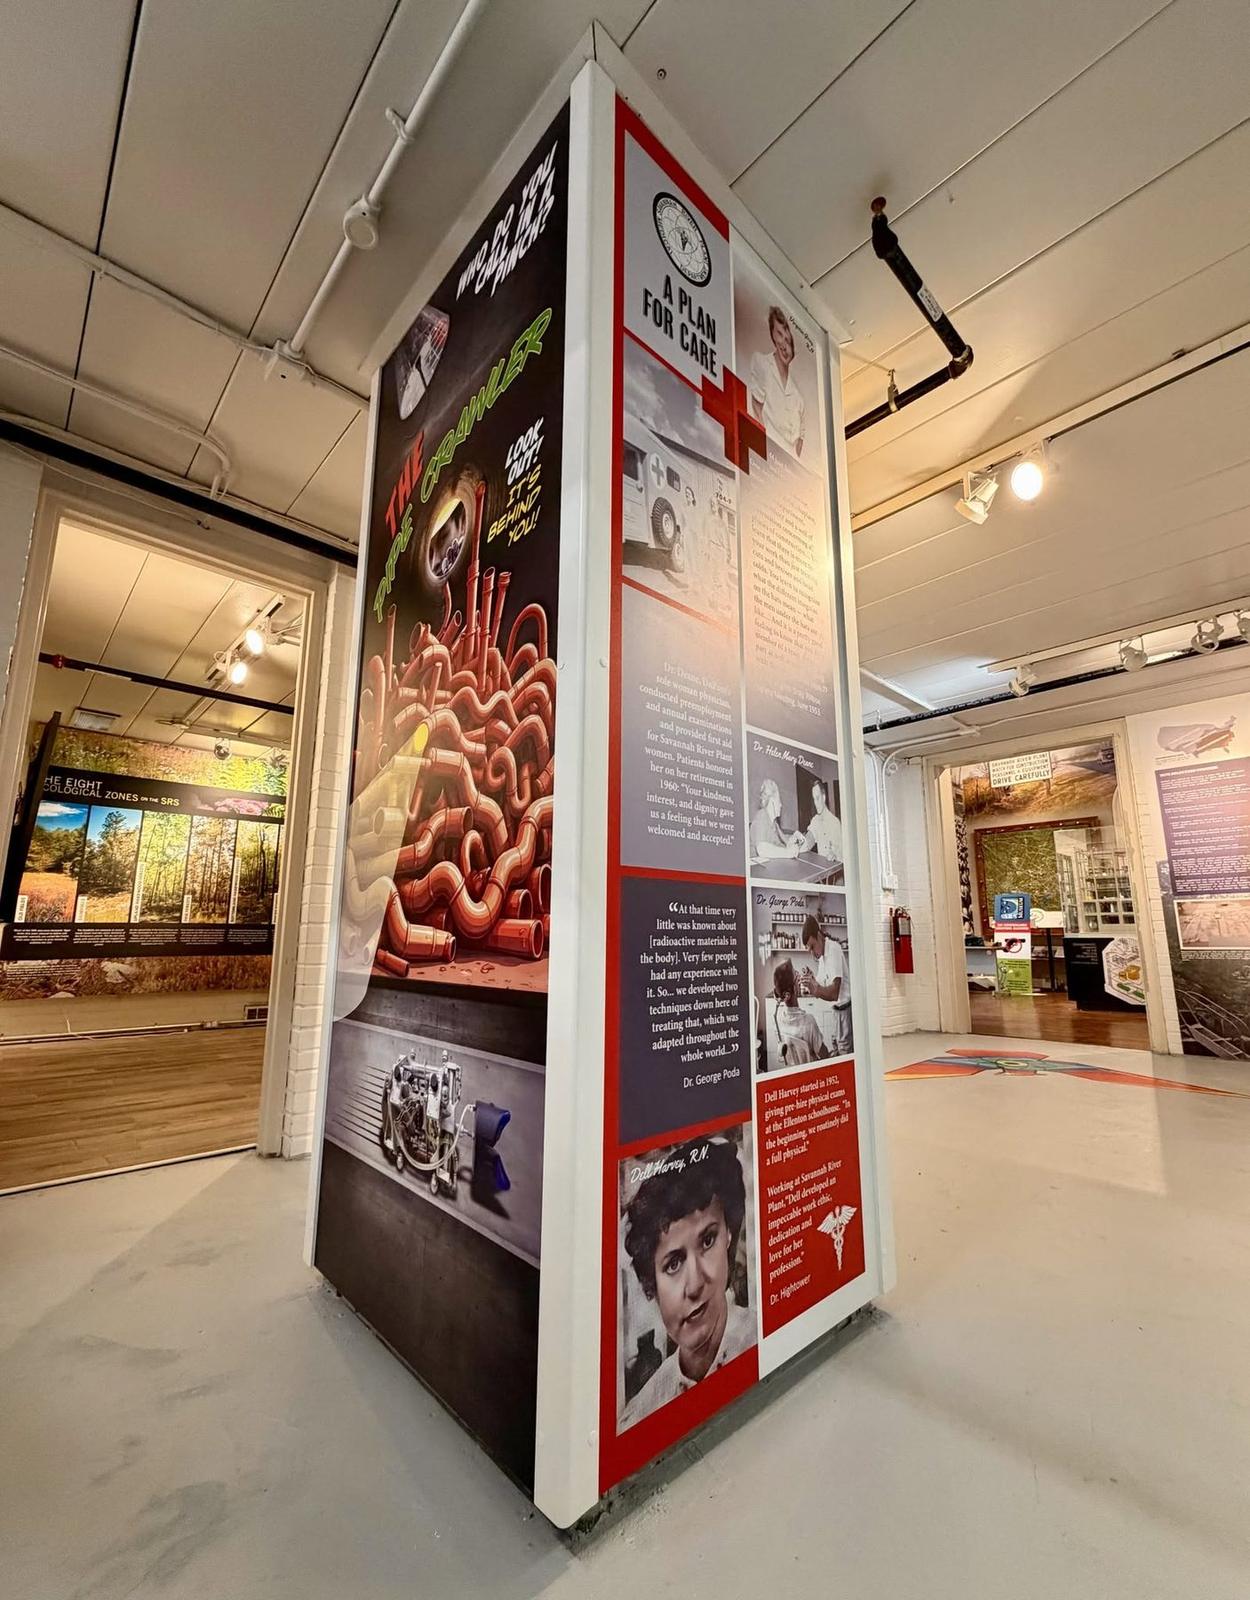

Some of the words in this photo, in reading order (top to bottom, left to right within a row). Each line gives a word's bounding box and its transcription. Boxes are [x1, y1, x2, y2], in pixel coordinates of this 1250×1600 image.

[456, 240, 488, 300] WHO
[491, 204, 514, 253] DO
[518, 140, 558, 215] YOU
[475, 231, 509, 294] CALL
[515, 193, 537, 242] IN
[538, 167, 555, 212] A
[490, 195, 554, 297] PINCH?
[662, 274, 673, 305] A
[678, 286, 716, 346] PLAN
[642, 287, 674, 340] FOR
[680, 322, 717, 378] CARE
[505, 416, 544, 469] LOOK
[373, 504, 413, 623] PIPE
[420, 308, 552, 503] CRAWLER
[507, 435, 544, 485] OUT!
[385, 430, 425, 538] THE
[506, 464, 542, 508] IT'S
[487, 485, 542, 544] BEHIND
[508, 505, 541, 547] YOU!
[640, 685, 678, 703] conducted
[656, 676, 670, 687] sole
[672, 681, 697, 696] woman
[646, 702, 660, 712] and
[662, 707, 686, 720] annual
[688, 716, 731, 735] examinations
[647, 730, 659, 743] for
[660, 734, 694, 751] Savannah
[696, 744, 714, 756] River
[716, 750, 732, 762] Plant
[659, 721, 673, 731] and
[675, 726, 706, 743] provided
[708, 734, 721, 745] first
[722, 738, 732, 748] aid
[645, 747, 675, 760] women.
[677, 753, 704, 768] Patients
[705, 760, 732, 775] honored
[753, 741, 765, 754] Dr.
[765, 745, 782, 760] Helen
[782, 750, 798, 767] Mary
[797, 755, 814, 769] Deane
[44, 775, 61, 786] HE
[65, 777, 102, 790] EIGHT
[650, 760, 663, 772] her
[676, 767, 688, 779] her
[690, 773, 724, 787] retirement
[993, 775, 1011, 785] DRIVE
[1015, 770, 1049, 781] CAREFULLY
[43, 783, 102, 798] COLOGICAL
[104, 791, 138, 802] ZONES
[160, 797, 180, 806] SRS
[647, 792, 677, 807] interest,
[679, 800, 692, 809] and
[694, 801, 718, 816] dignity
[719, 808, 734, 817] gave
[660, 779, 679, 791] 1960:
[703, 788, 733, 804] kindness,
[648, 824, 685, 838] welcomed
[687, 830, 700, 840] and
[667, 810, 692, 826] feeling
[693, 816, 706, 826] that
[719, 822, 734, 831] were
[657, 919, 674, 929] little
[692, 920, 716, 929] known
[717, 921, 736, 930] about
[689, 905, 703, 914] that
[705, 906, 720, 914] time
[722, 908, 736, 918] very
[650, 935, 695, 948] [radioactive
[697, 936, 728, 945] materials
[640, 953, 653, 963] the
[655, 952, 680, 965] body].
[682, 952, 699, 964] Very
[701, 951, 713, 961] few
[715, 951, 737, 963] people
[651, 969, 665, 980] had
[667, 971, 681, 981] any
[683, 968, 721, 980] experience
[723, 966, 737, 975] with
[657, 986, 674, 997] So...
[688, 982, 724, 995] developed
[725, 983, 738, 991] two
[650, 1003, 691, 1015] techniques
[693, 1000, 713, 1010] down
[715, 998, 730, 1008] here
[731, 995, 739, 1006] of
[652, 1020, 683, 1032] treating
[685, 1017, 702, 1028] that,
[704, 1014, 724, 1025] which
[652, 1035, 684, 1051] adapted
[686, 1030, 726, 1044] throughout
[728, 1027, 739, 1037] the
[681, 1049, 703, 1061] whole
[684, 1077, 693, 1087] Dr.
[696, 1073, 721, 1084] George
[723, 1067, 739, 1078] Poda
[765, 1091, 777, 1102] Dell
[779, 1088, 799, 1099] Harvey
[800, 1080, 818, 1093] started
[765, 1107, 784, 1121] giving
[785, 1099, 807, 1115] pre-hire
[808, 1091, 829, 1108] physical
[766, 1139, 776, 1149] the
[817, 1116, 839, 1131] routinely
[840, 1113, 848, 1123] did
[772, 1121, 782, 1131] the
[784, 1115, 807, 1128] Ellenton
[630, 1162, 653, 1183] Dell
[690, 1144, 709, 1164] R.N.
[771, 1151, 782, 1164] full
[767, 1180, 793, 1196] Working
[801, 1165, 827, 1183] Savannah
[828, 1160, 841, 1171] River
[768, 1197, 786, 1213] Plant,
[801, 1178, 829, 1198] developed
[768, 1207, 801, 1230] impeccable
[802, 1199, 816, 1212] work
[768, 1225, 800, 1246] dedication
[801, 1216, 812, 1229] and
[769, 1250, 782, 1263] love
[770, 1294, 779, 1305] Dr.
[780, 1274, 810, 1298] Hightower
